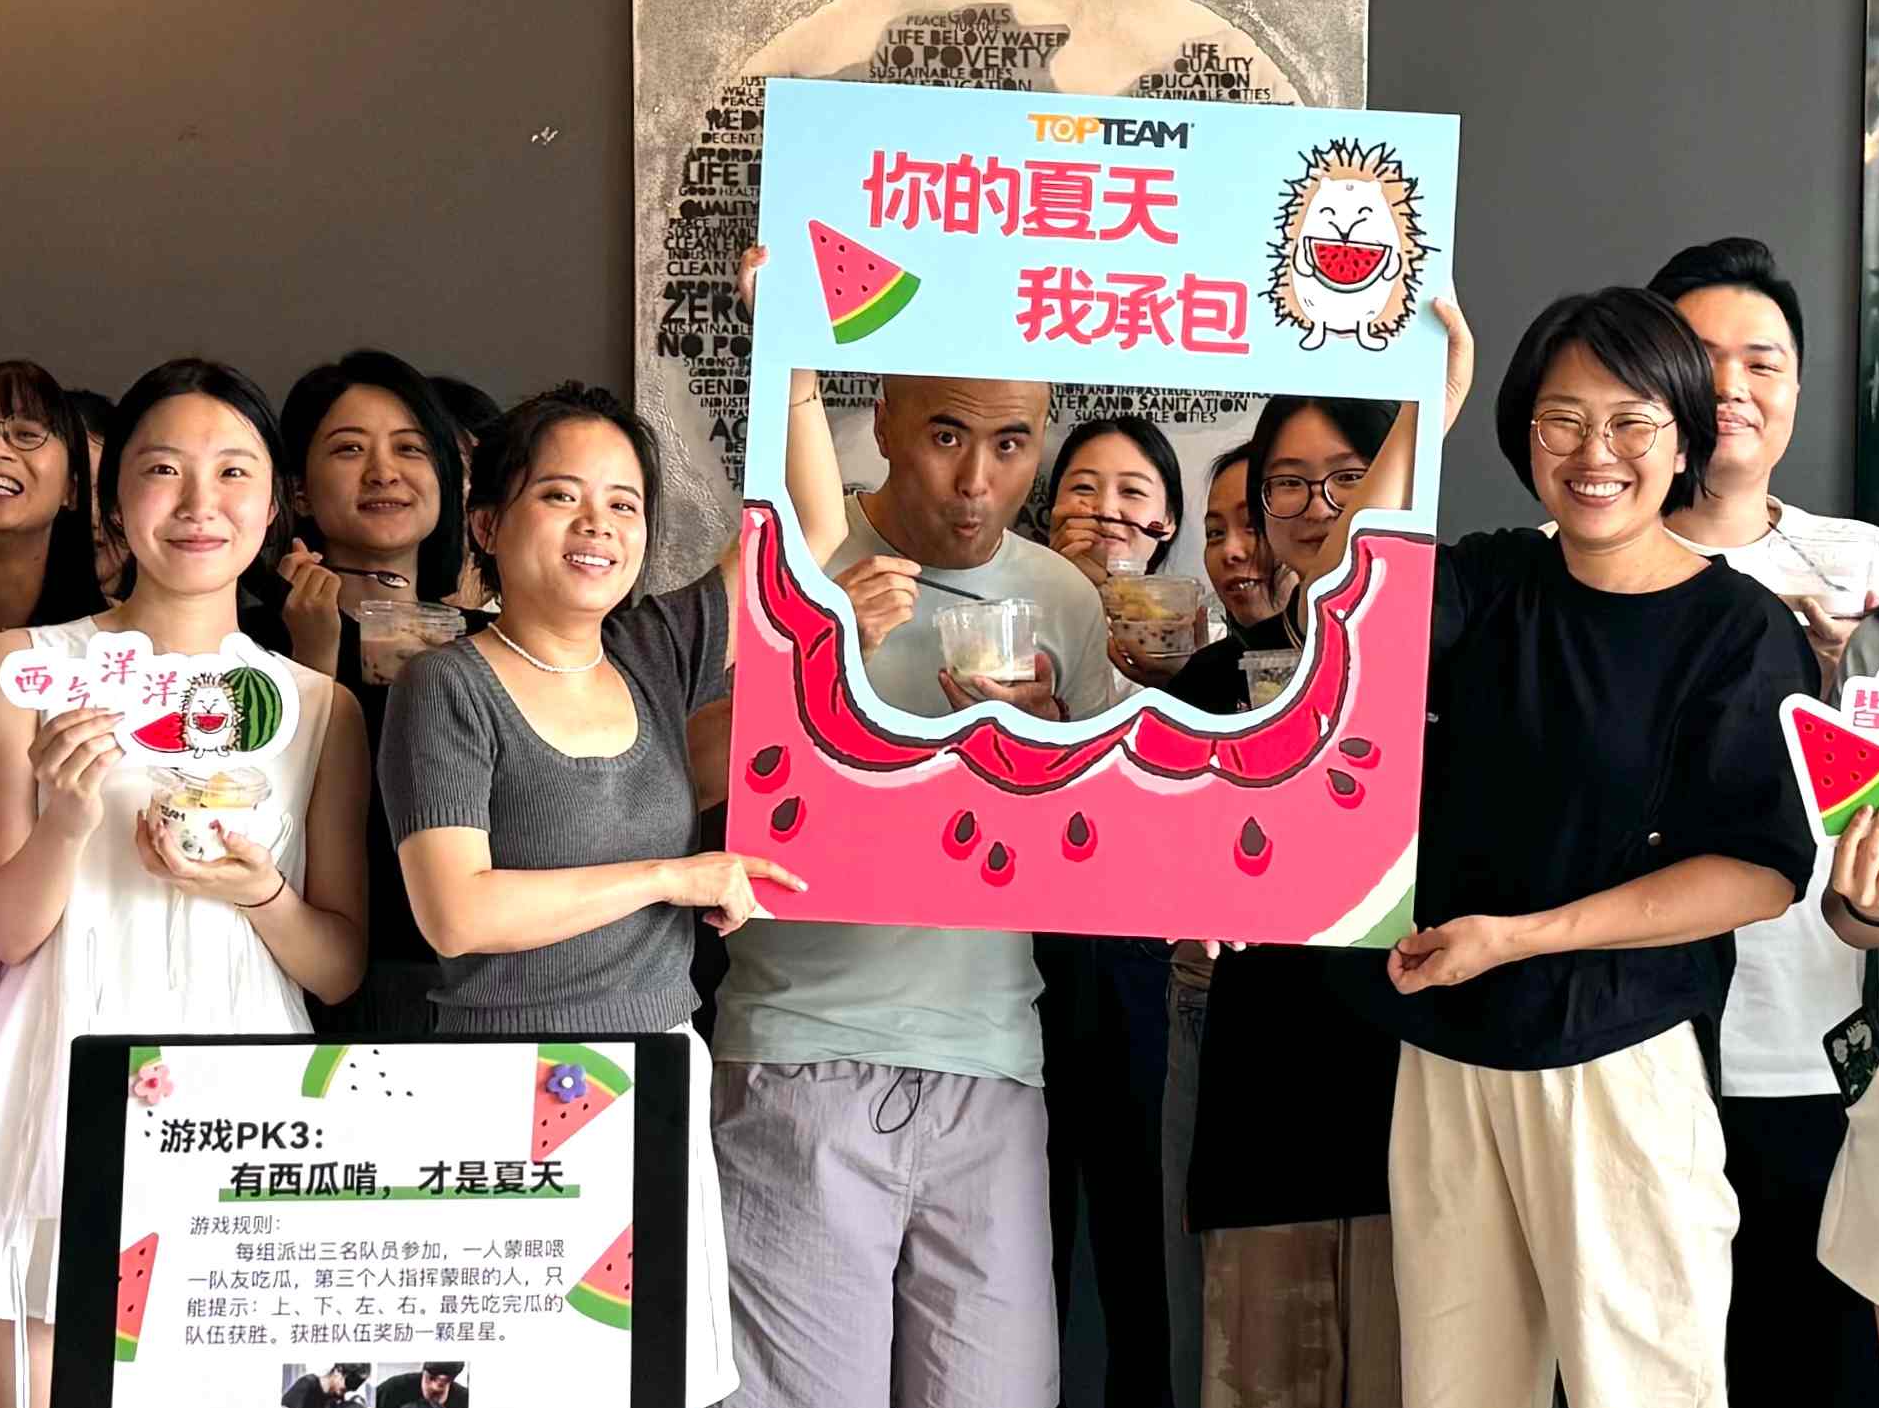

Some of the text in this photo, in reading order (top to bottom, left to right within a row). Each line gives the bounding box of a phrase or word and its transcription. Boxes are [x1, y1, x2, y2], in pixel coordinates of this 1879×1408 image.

[906, 7, 1011, 27] PEACE GOALS
[887, 29, 1071, 48] LIFE BELOW WATER
[874, 45, 1060, 69] NO POVERTY
[1182, 43, 1219, 59] LIFE
[869, 67, 965, 79] SUSTAINABLE
[1173, 57, 1254, 73] QUALITY
[1139, 73, 1250, 90] EDUCATION
[1130, 89, 1223, 101] USTAINABLE
[701, 132, 756, 144] DECENT
[1027, 113, 1189, 149] TOPTEAM
[683, 163, 740, 186] LIFE
[862, 149, 1179, 245] 你的夏天
[667, 261, 726, 276] CLEAN
[1015, 266, 1250, 354] 我承包
[1093, 396, 1134, 410] AND
[1138, 395, 1248, 413] SANITATION
[1075, 409, 1170, 424] SUSTABLE
